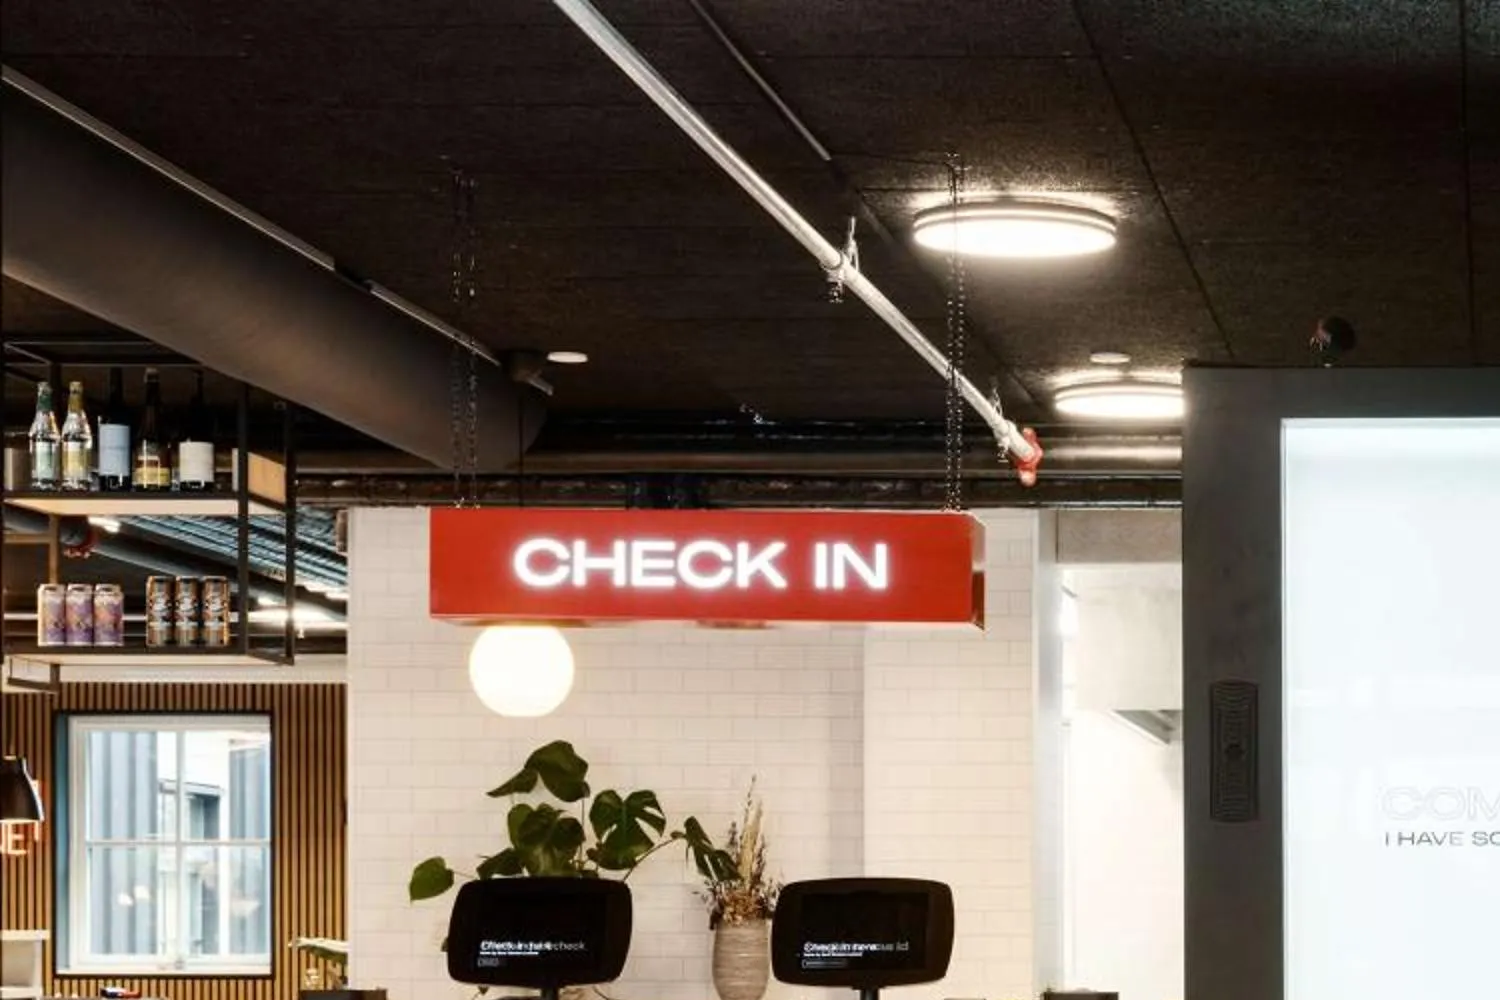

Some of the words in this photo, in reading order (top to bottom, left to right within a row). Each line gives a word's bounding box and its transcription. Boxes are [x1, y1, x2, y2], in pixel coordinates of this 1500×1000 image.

[513, 537, 788, 589] CHECK
[813, 541, 888, 590] IN
[1384, 831, 1390, 846] I
[1397, 831, 1465, 847] HAVE
